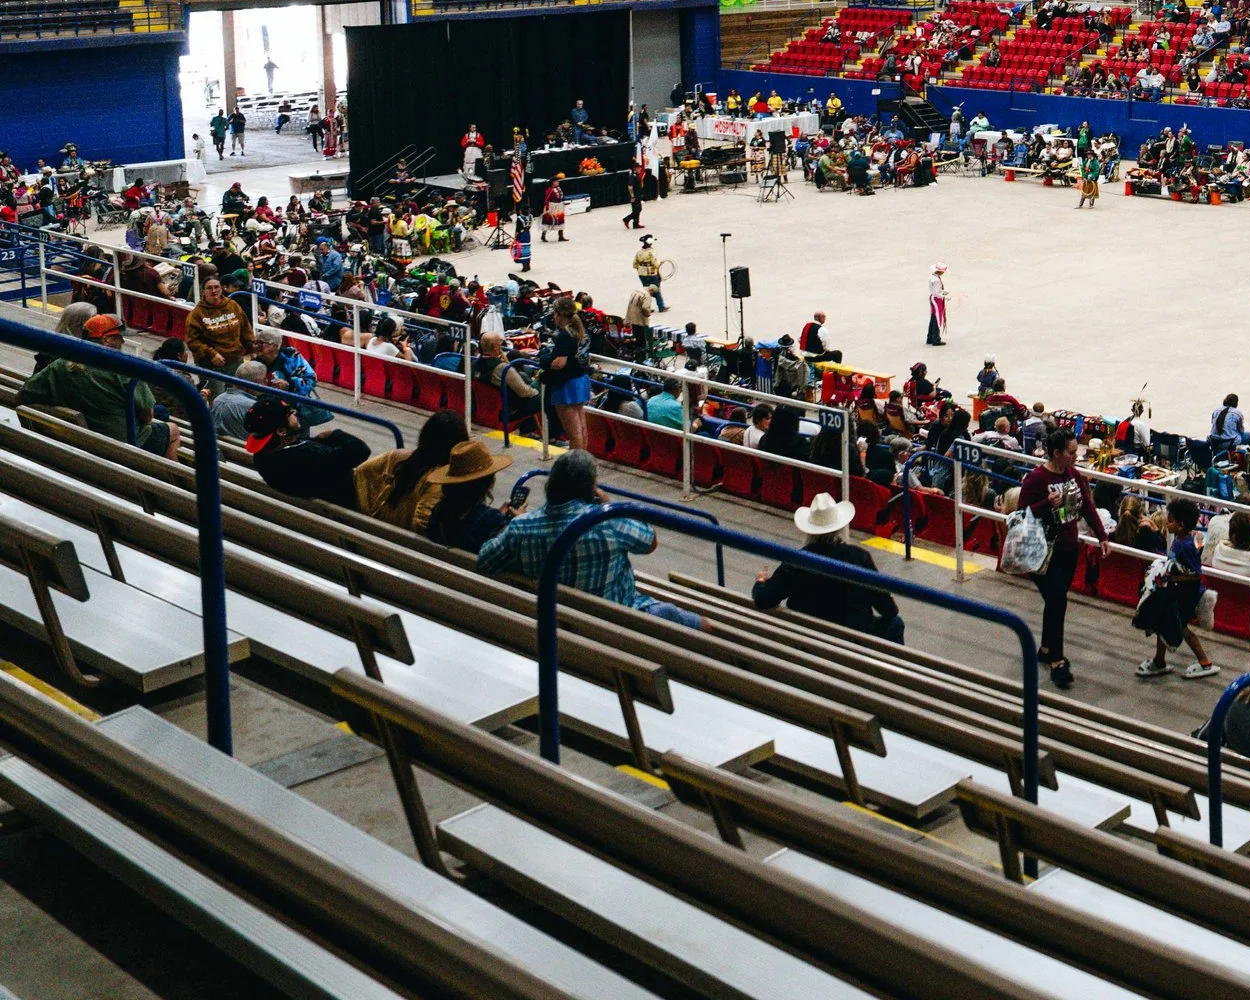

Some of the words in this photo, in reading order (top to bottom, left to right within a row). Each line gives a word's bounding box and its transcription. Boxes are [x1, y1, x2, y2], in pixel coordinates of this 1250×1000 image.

[182, 265, 194, 277] 122
[252, 281, 264, 294] 121
[450, 326, 464, 340] 121
[820, 411, 842, 428] 120
[956, 444, 980, 463] 119
